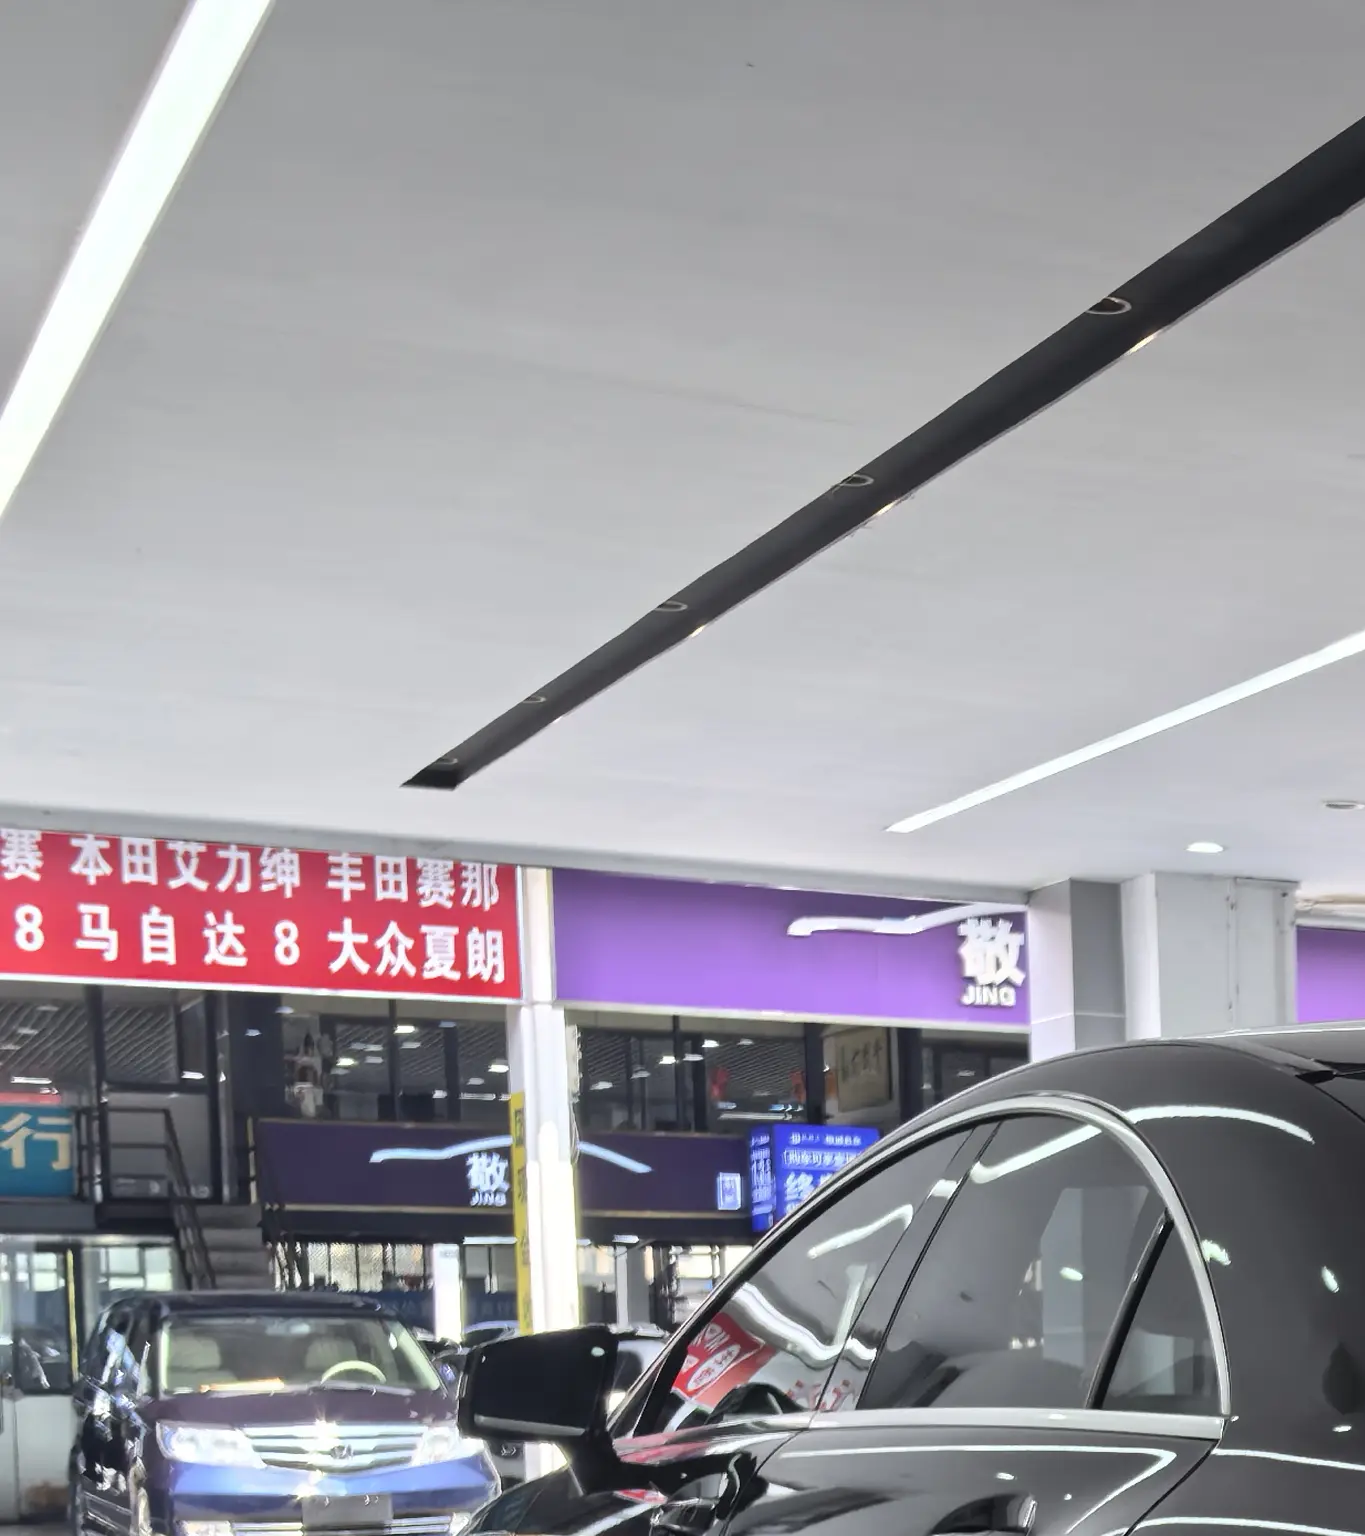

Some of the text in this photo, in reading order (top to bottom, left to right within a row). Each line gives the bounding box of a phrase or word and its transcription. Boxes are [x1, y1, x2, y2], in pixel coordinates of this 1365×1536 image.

[70, 834, 300, 898] 本田艾力绅
[327, 852, 499, 912] 丰田赛那
[327, 917, 505, 984] 大众夏朗
[958, 917, 1025, 987] 敬
[961, 984, 1016, 1006] JING
[0, 1112, 73, 1171] 行
